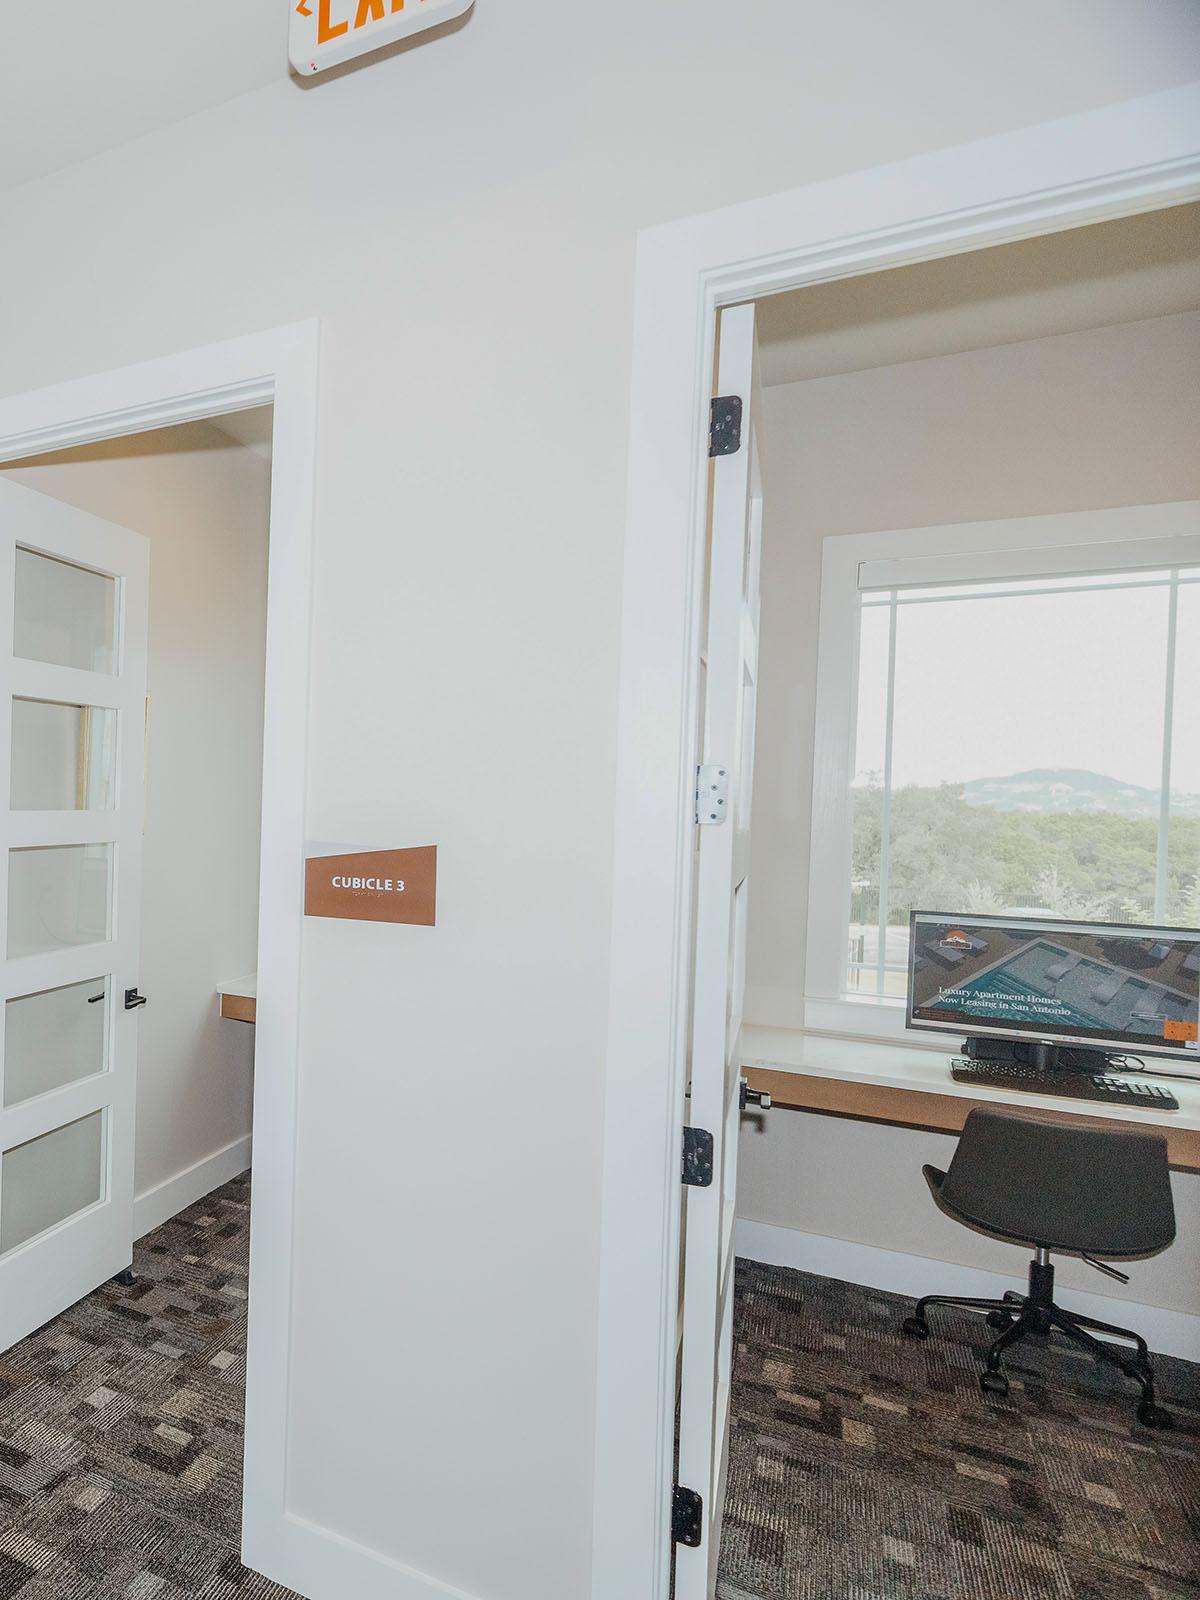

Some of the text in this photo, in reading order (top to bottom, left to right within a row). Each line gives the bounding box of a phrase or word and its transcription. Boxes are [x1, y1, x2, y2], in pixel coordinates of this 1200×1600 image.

[331, 876, 405, 892] CUBICLE 3
[939, 986, 1062, 1005] Luxury Apartment Homes
[939, 995, 1071, 1016] Now Leasing in San Antonio
